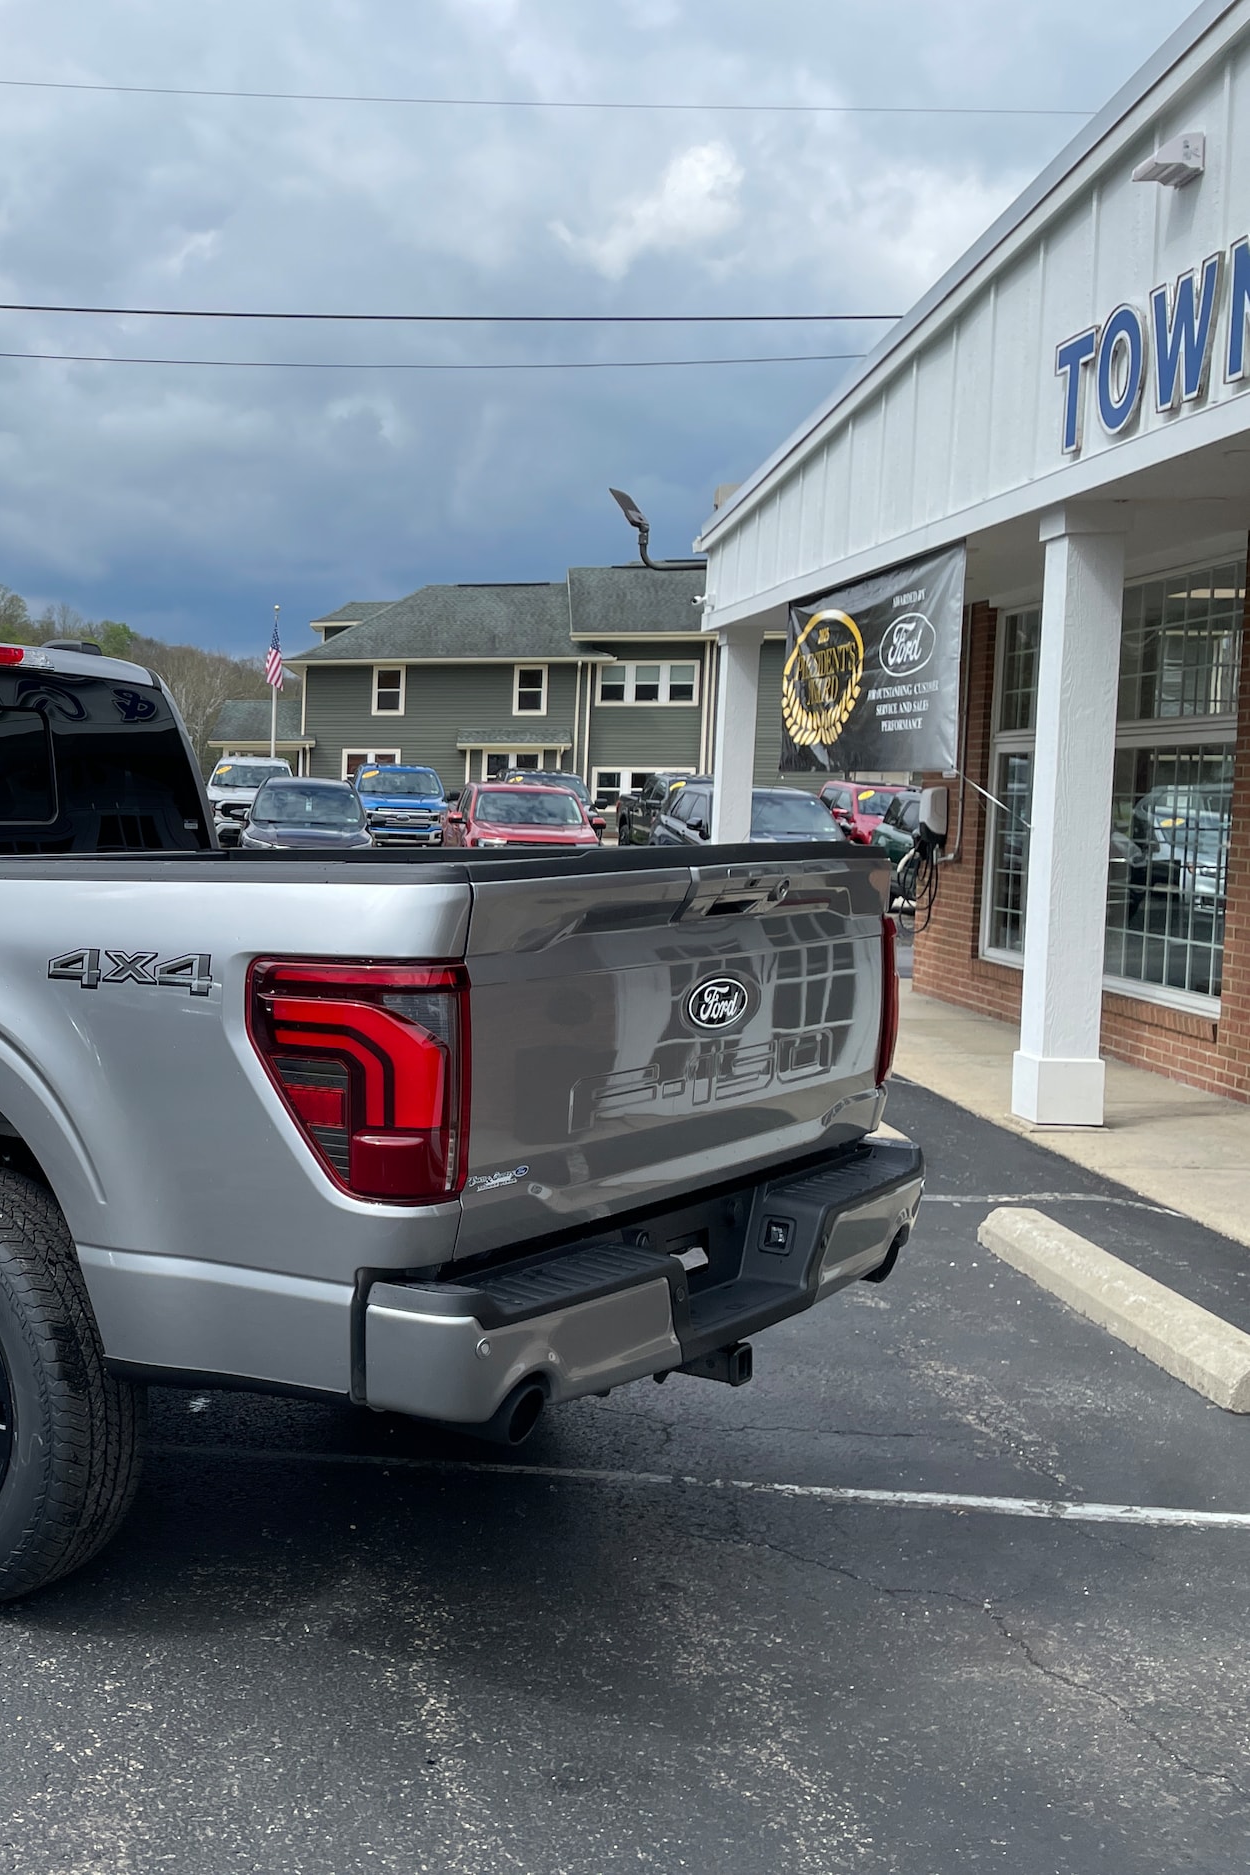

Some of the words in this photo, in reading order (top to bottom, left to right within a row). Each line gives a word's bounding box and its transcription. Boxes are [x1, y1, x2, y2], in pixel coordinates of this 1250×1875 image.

[888, 622, 922, 666] Ford
[881, 717, 923, 732] PERFORMANCE
[898, 701, 912, 714] AND
[699, 985, 738, 1021] Ford
[568, 1029, 832, 1134] F-150
